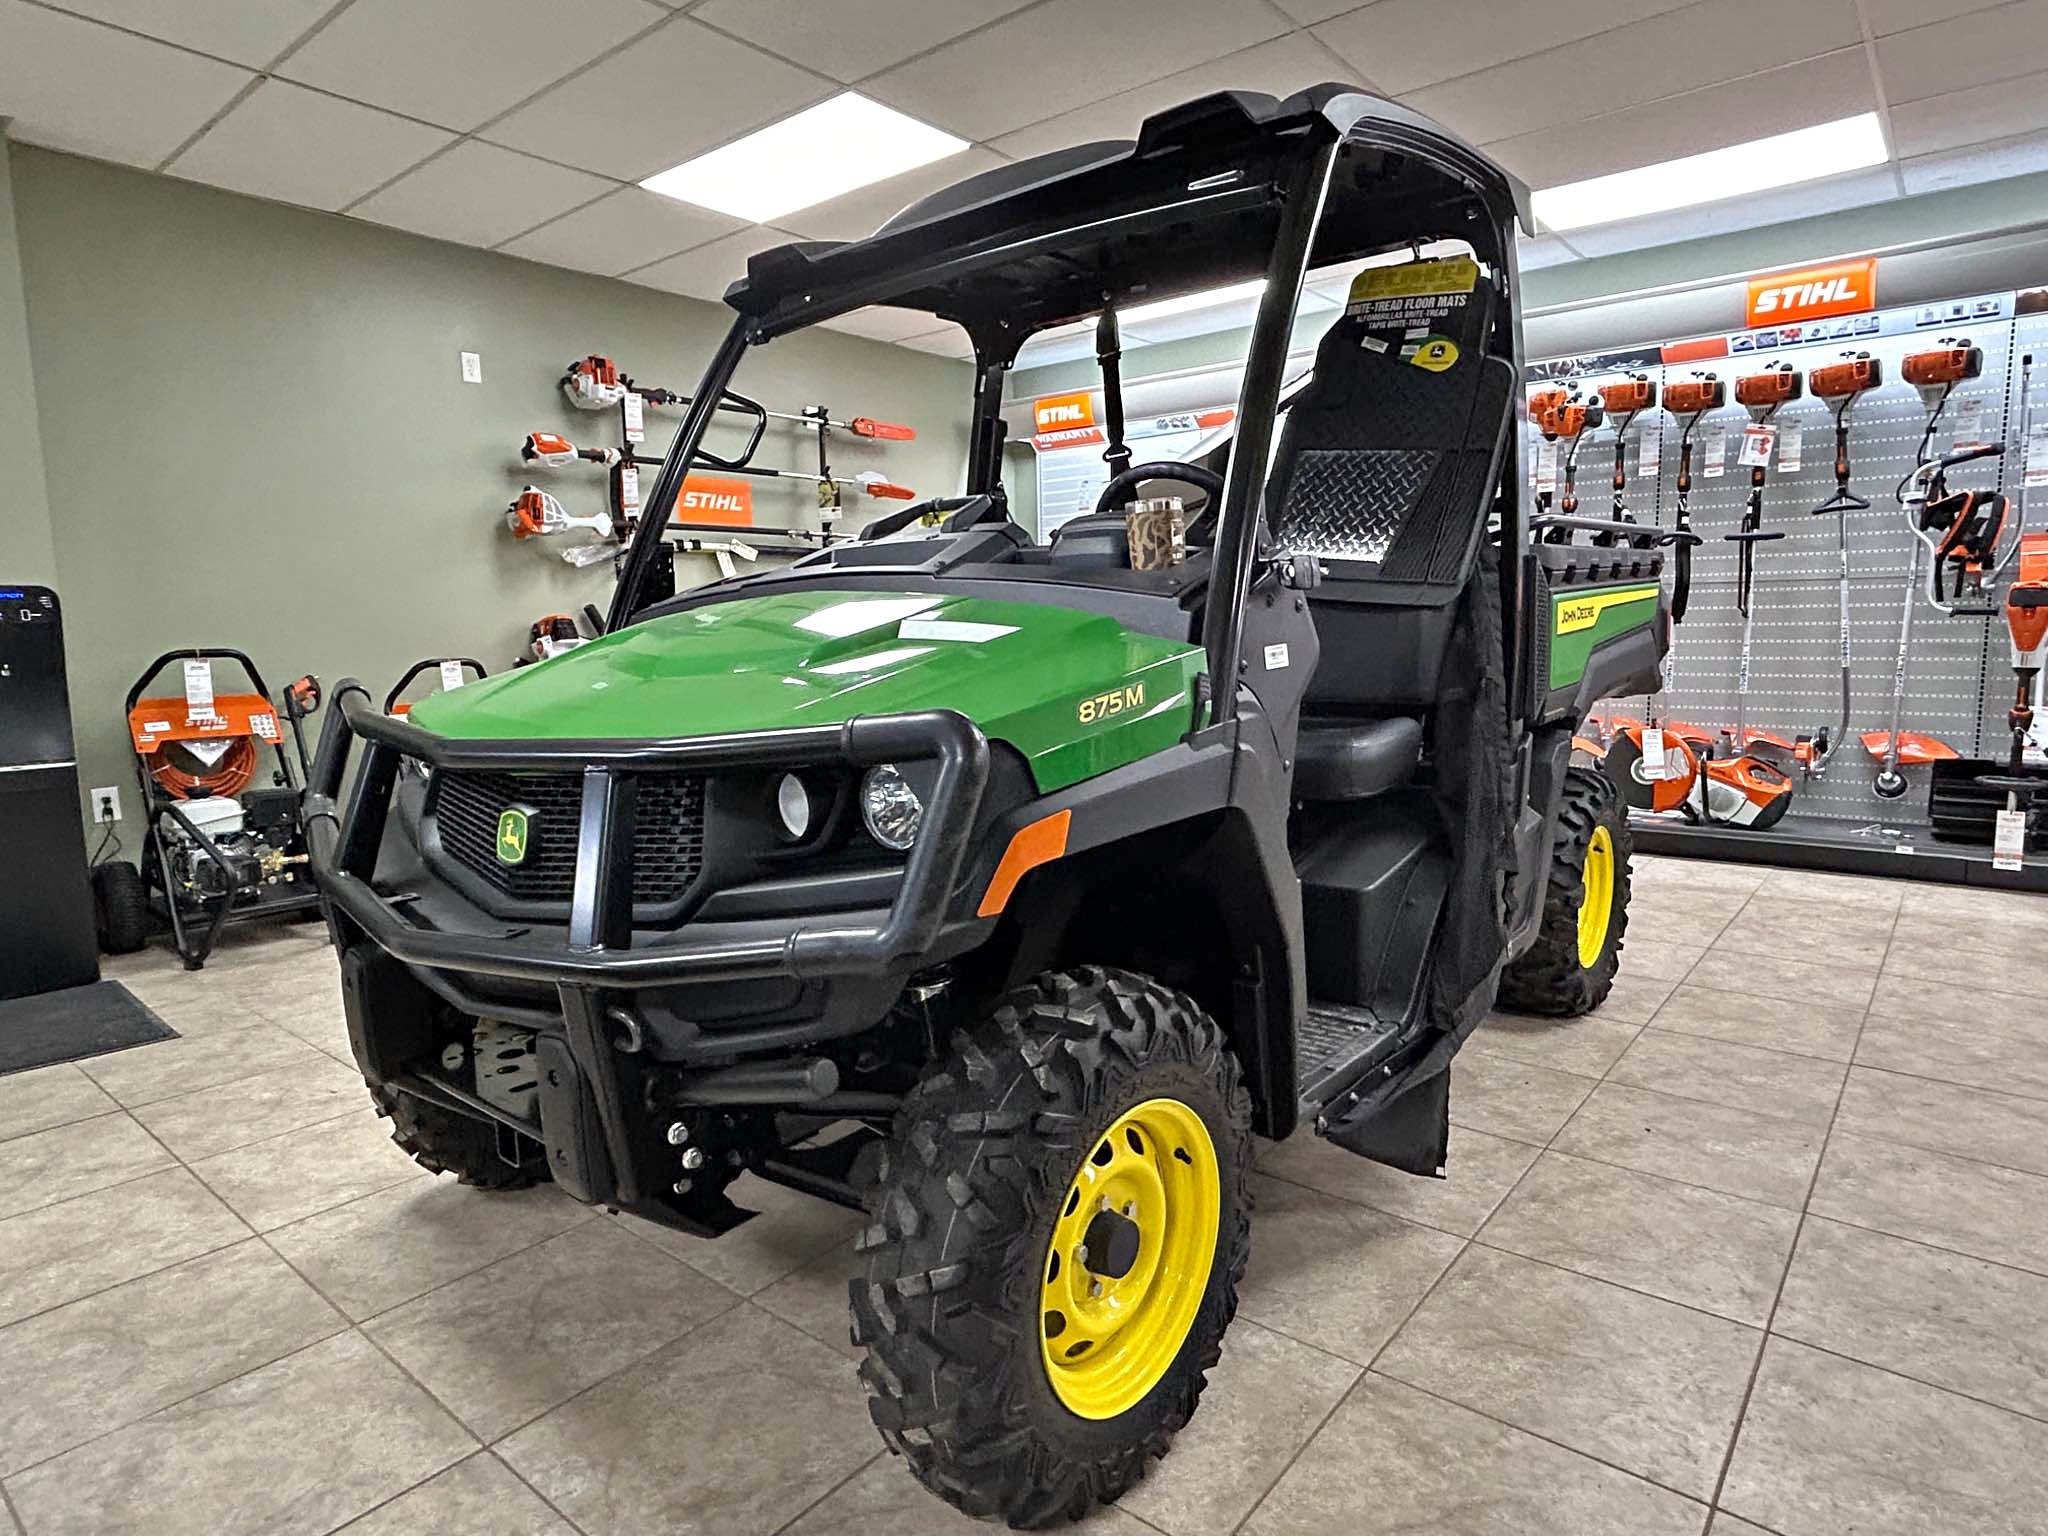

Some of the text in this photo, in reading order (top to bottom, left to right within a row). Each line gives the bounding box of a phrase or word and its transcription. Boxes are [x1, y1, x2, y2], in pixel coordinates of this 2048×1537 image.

[1404, 297, 1436, 310] FLOOR
[1437, 294, 1467, 308] MATS
[1753, 277, 1857, 313] STIHL
[1038, 404, 1085, 425] STIHL
[683, 491, 743, 512] STIHL
[1561, 606, 1595, 624] JOHN DEERE
